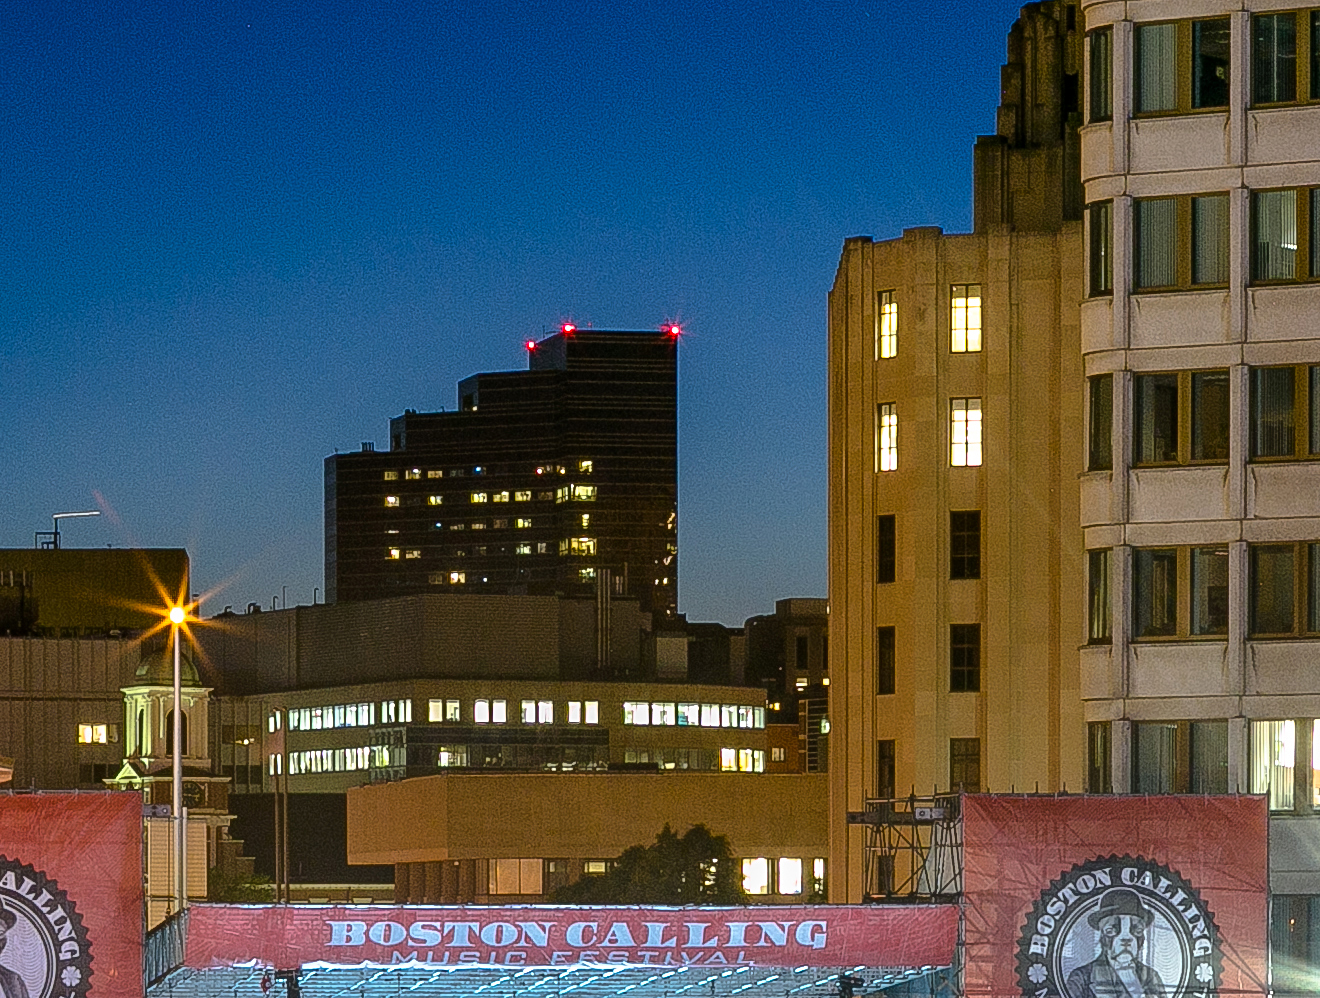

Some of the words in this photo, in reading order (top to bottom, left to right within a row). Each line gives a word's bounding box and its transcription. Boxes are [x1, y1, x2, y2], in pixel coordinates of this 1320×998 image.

[1029, 867, 1112, 958] BOSTON
[1121, 867, 1212, 957] CALLING
[325, 920, 557, 947] BOSTON
[566, 921, 827, 949] CALLING
[391, 951, 527, 965] MUSIC
[550, 951, 756, 965] FESTIVAL
